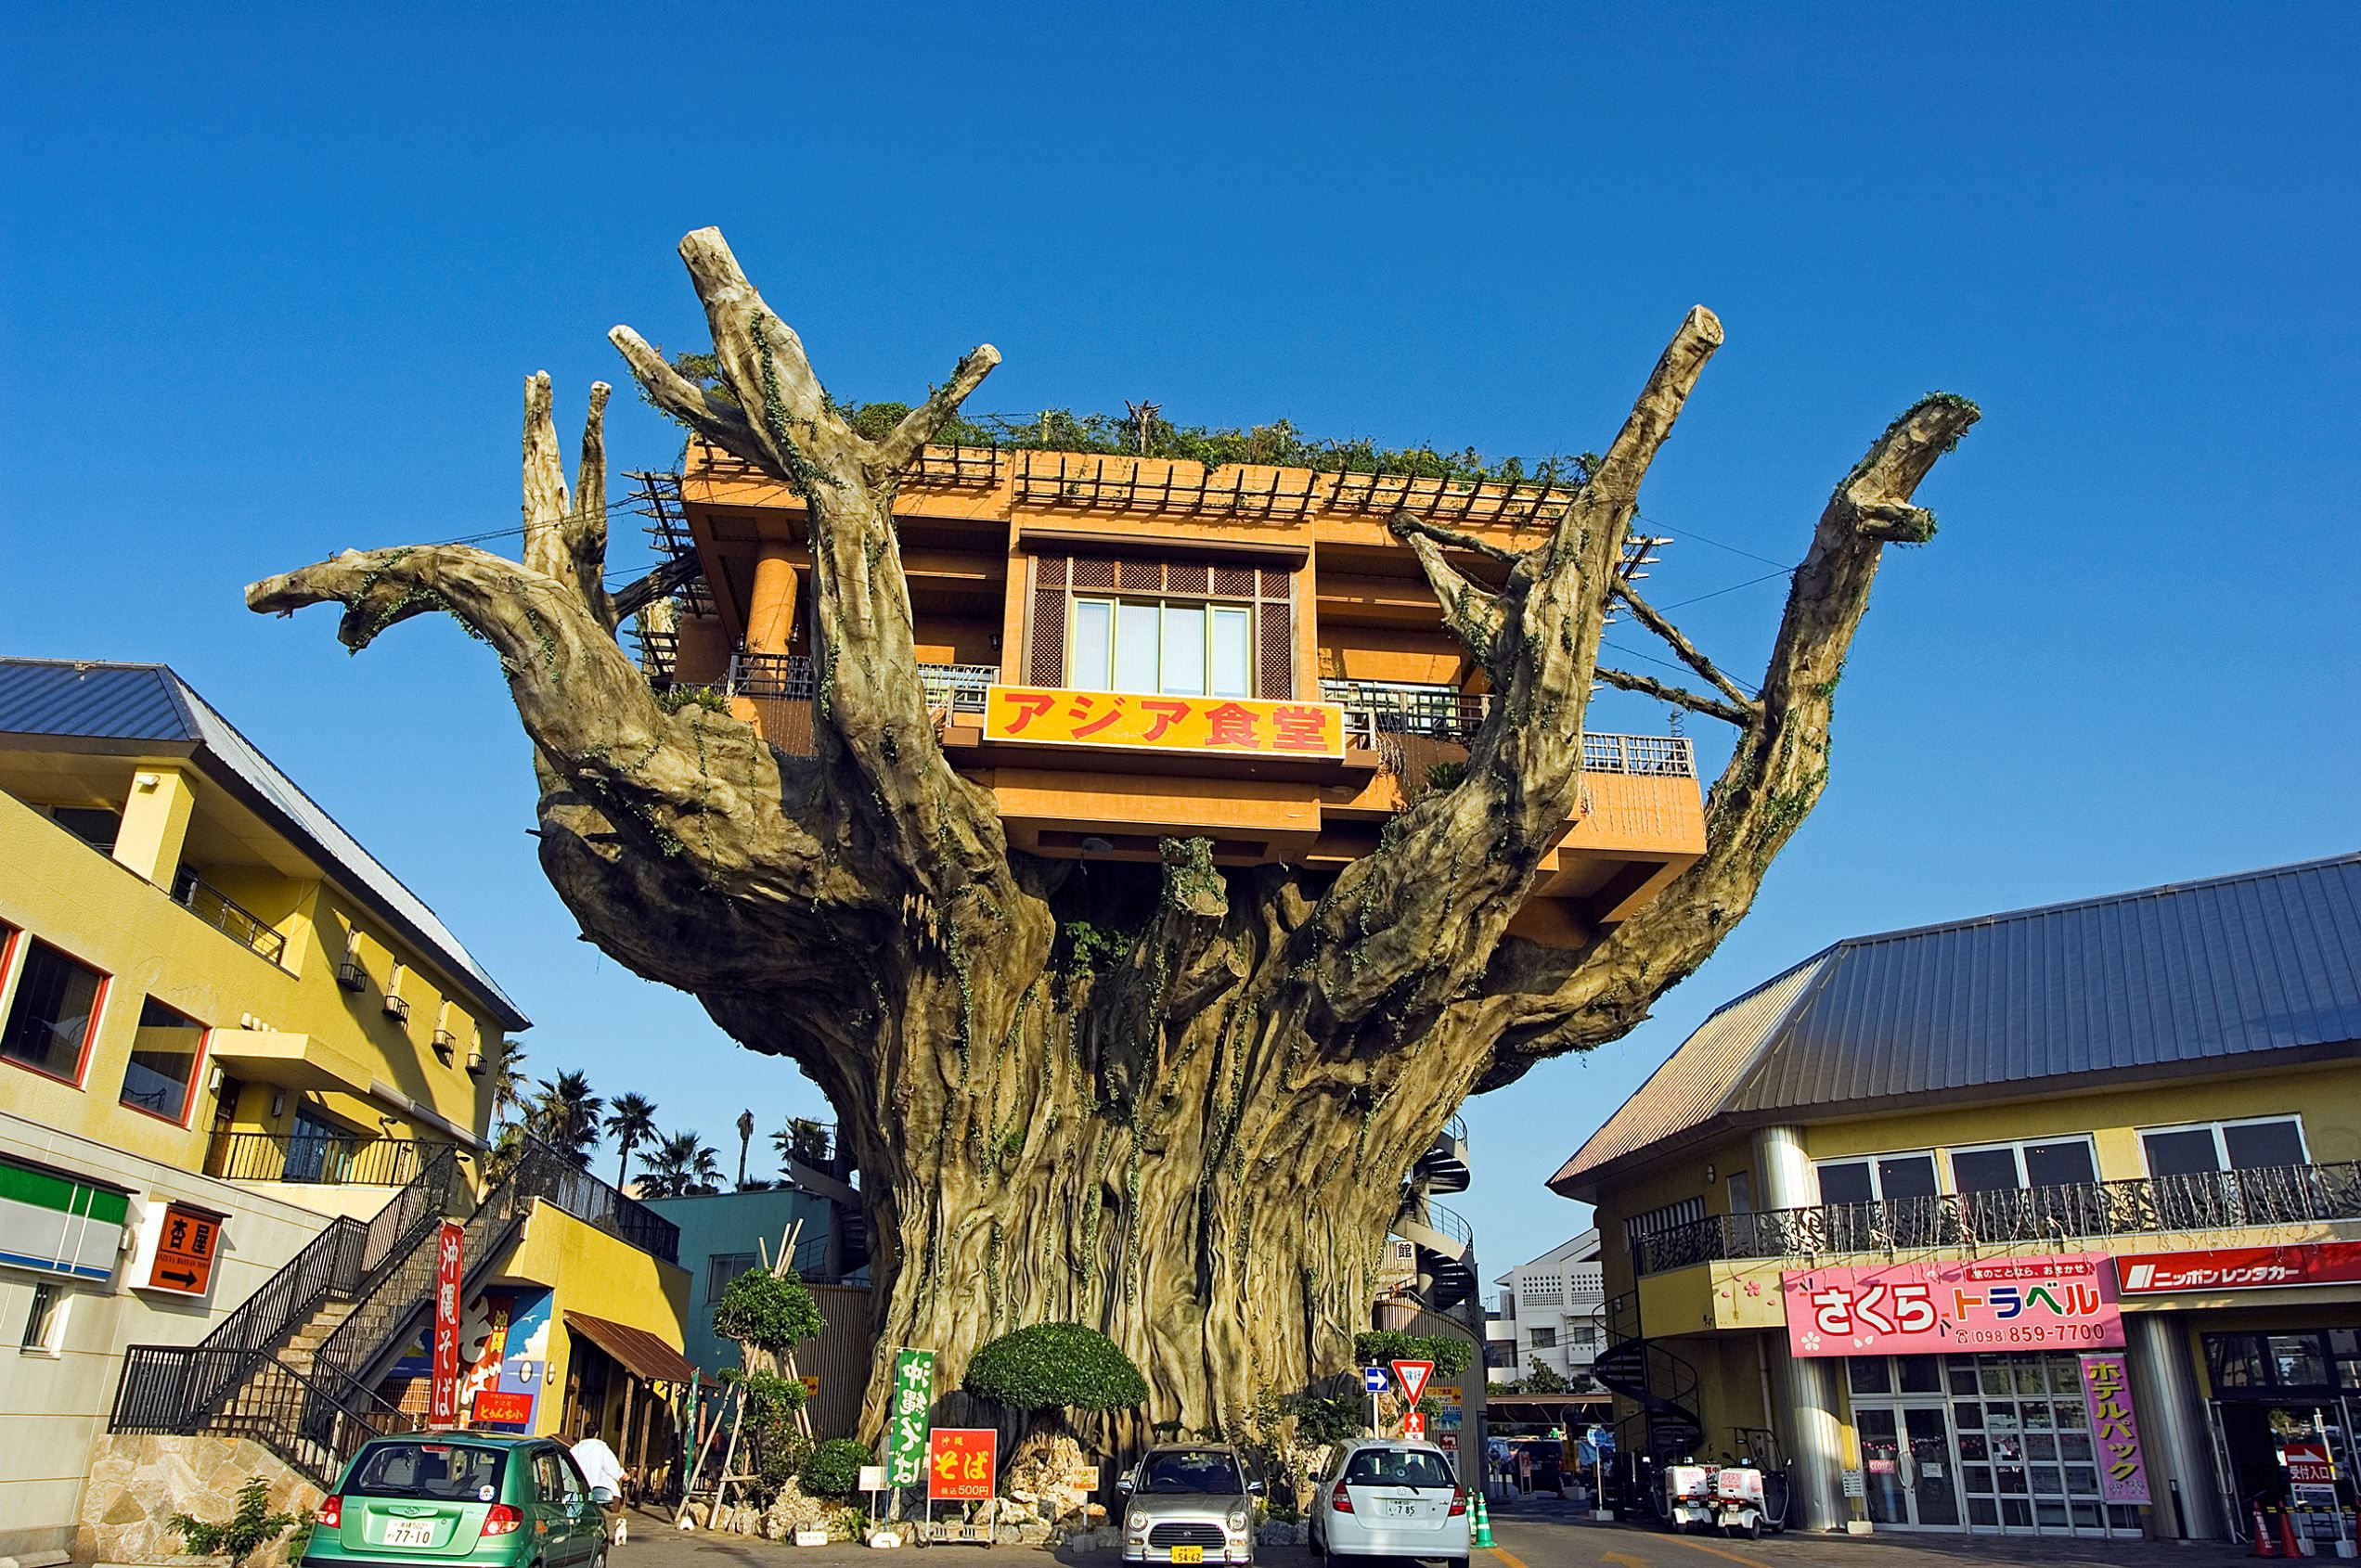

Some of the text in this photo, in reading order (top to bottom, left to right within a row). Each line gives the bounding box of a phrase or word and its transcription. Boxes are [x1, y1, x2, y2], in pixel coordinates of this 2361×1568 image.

[1003, 692, 1329, 752] アジア食堂
[170, 1217, 210, 1254] 杏屋
[1398, 1243, 1412, 1258] 館
[436, 1235, 459, 1418] 沖縄そば
[1812, 1280, 2102, 1338] さくら トラベル
[2088, 1361, 2138, 1481] ホテルパック
[941, 1436, 963, 1447] 沖縄
[935, 1450, 989, 1480] そば
[2290, 1465, 2330, 1480] 受付入口
